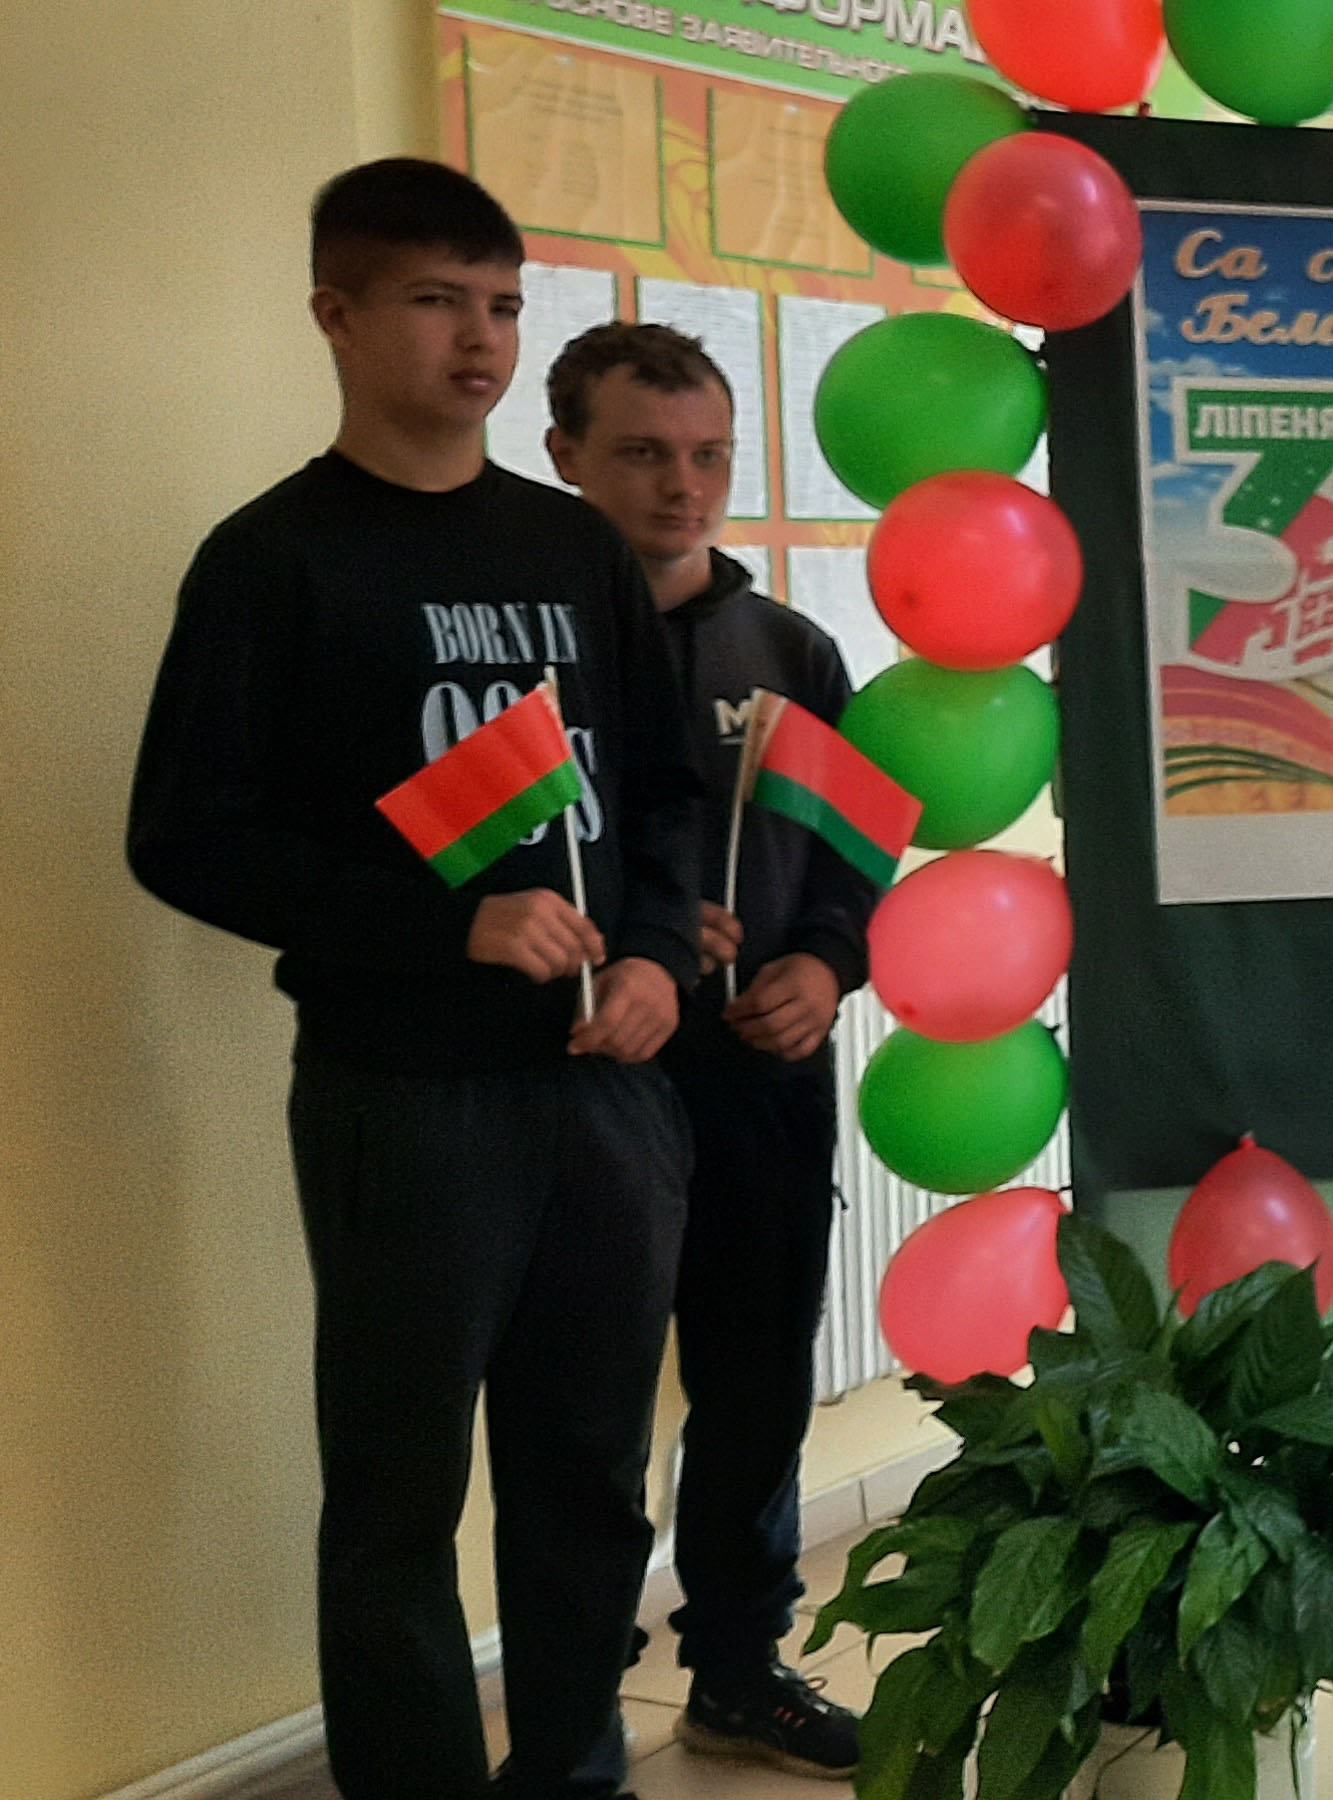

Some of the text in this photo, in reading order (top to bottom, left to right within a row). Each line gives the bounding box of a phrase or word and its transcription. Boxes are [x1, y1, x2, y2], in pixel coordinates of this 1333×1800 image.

[681, 13, 911, 84] ЗАЯВИТЕЛЬНО
[1175, 230, 1267, 280] Са
[421, 602, 578, 664] BORN IN
